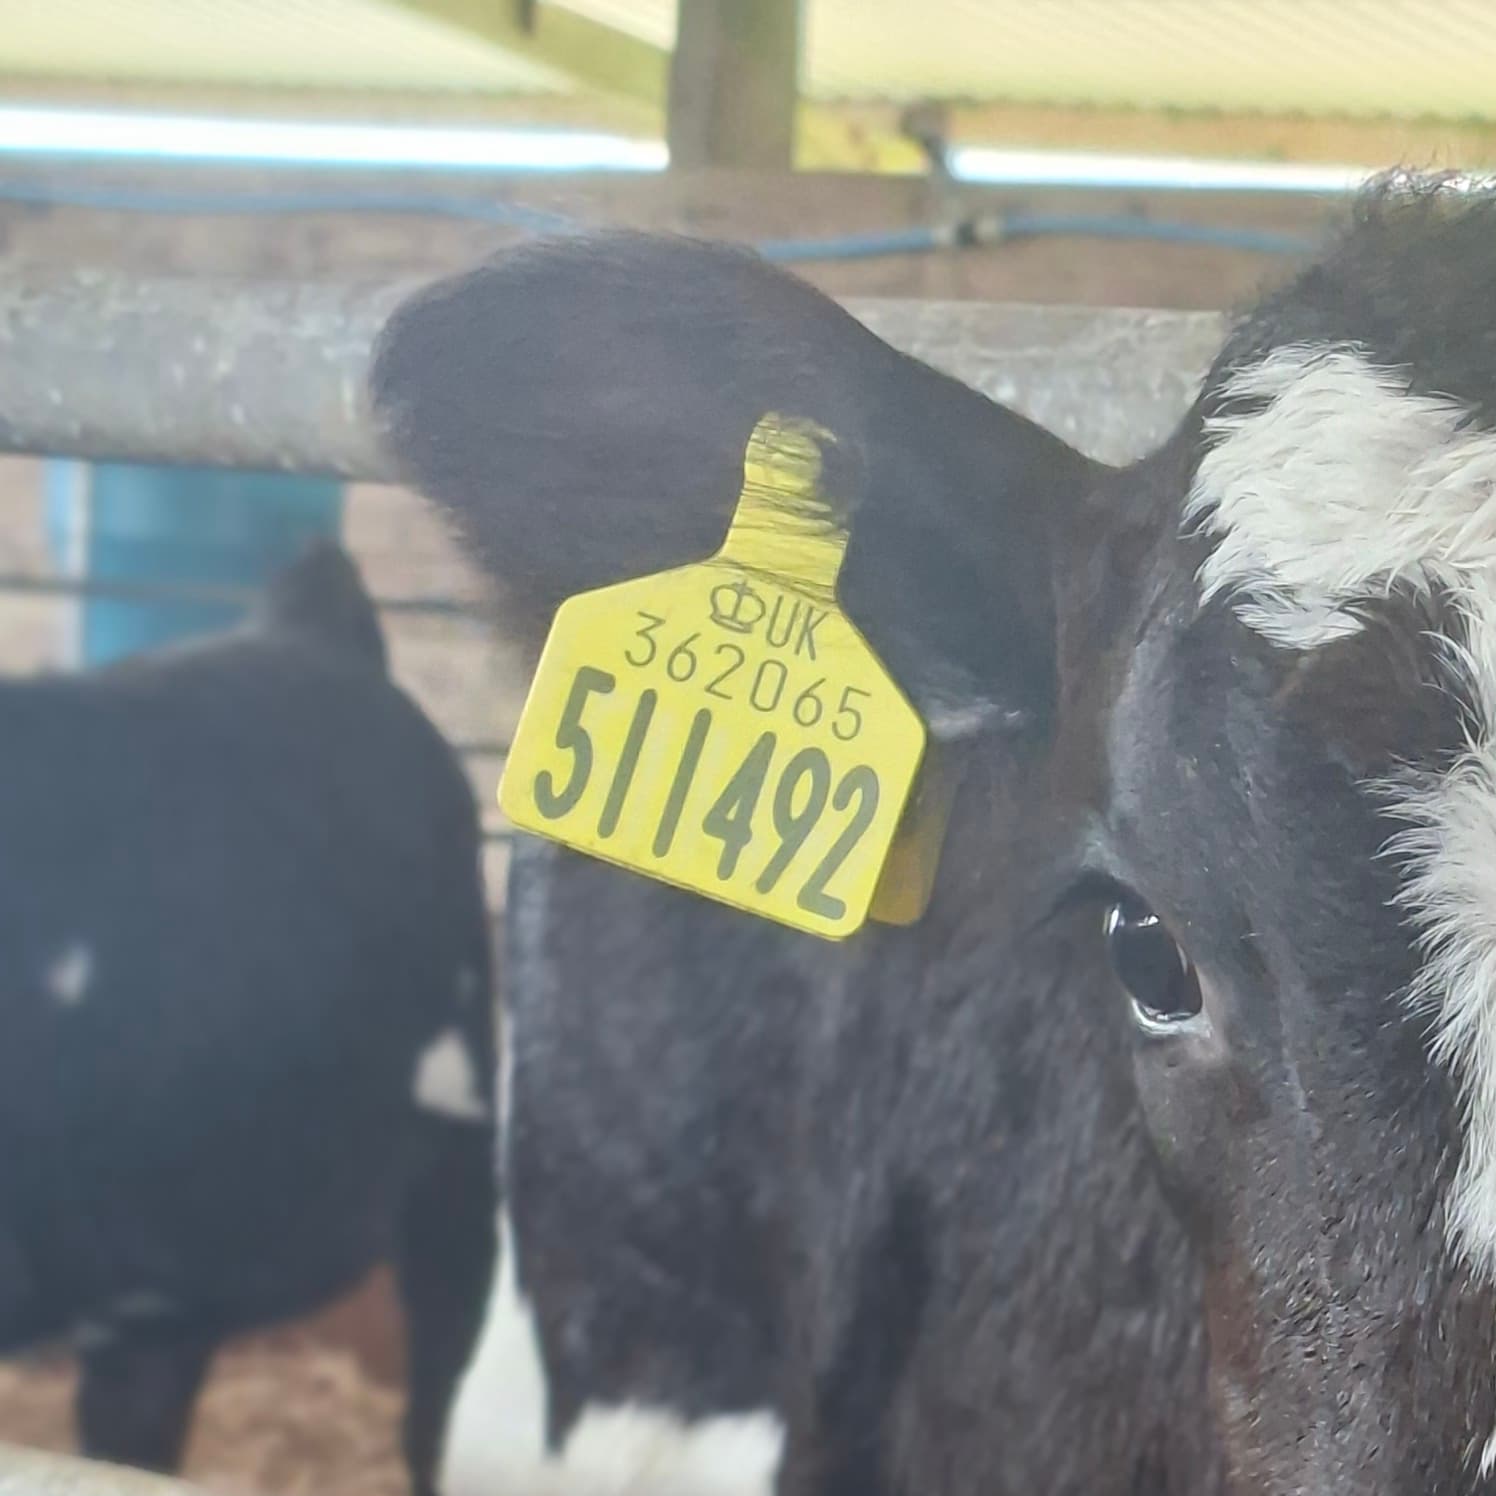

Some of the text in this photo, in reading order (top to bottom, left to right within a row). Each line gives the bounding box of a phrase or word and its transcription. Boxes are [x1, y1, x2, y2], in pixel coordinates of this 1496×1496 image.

[624, 611, 872, 741] 362065
[766, 595, 831, 660] UK
[533, 665, 880, 920] 511492
